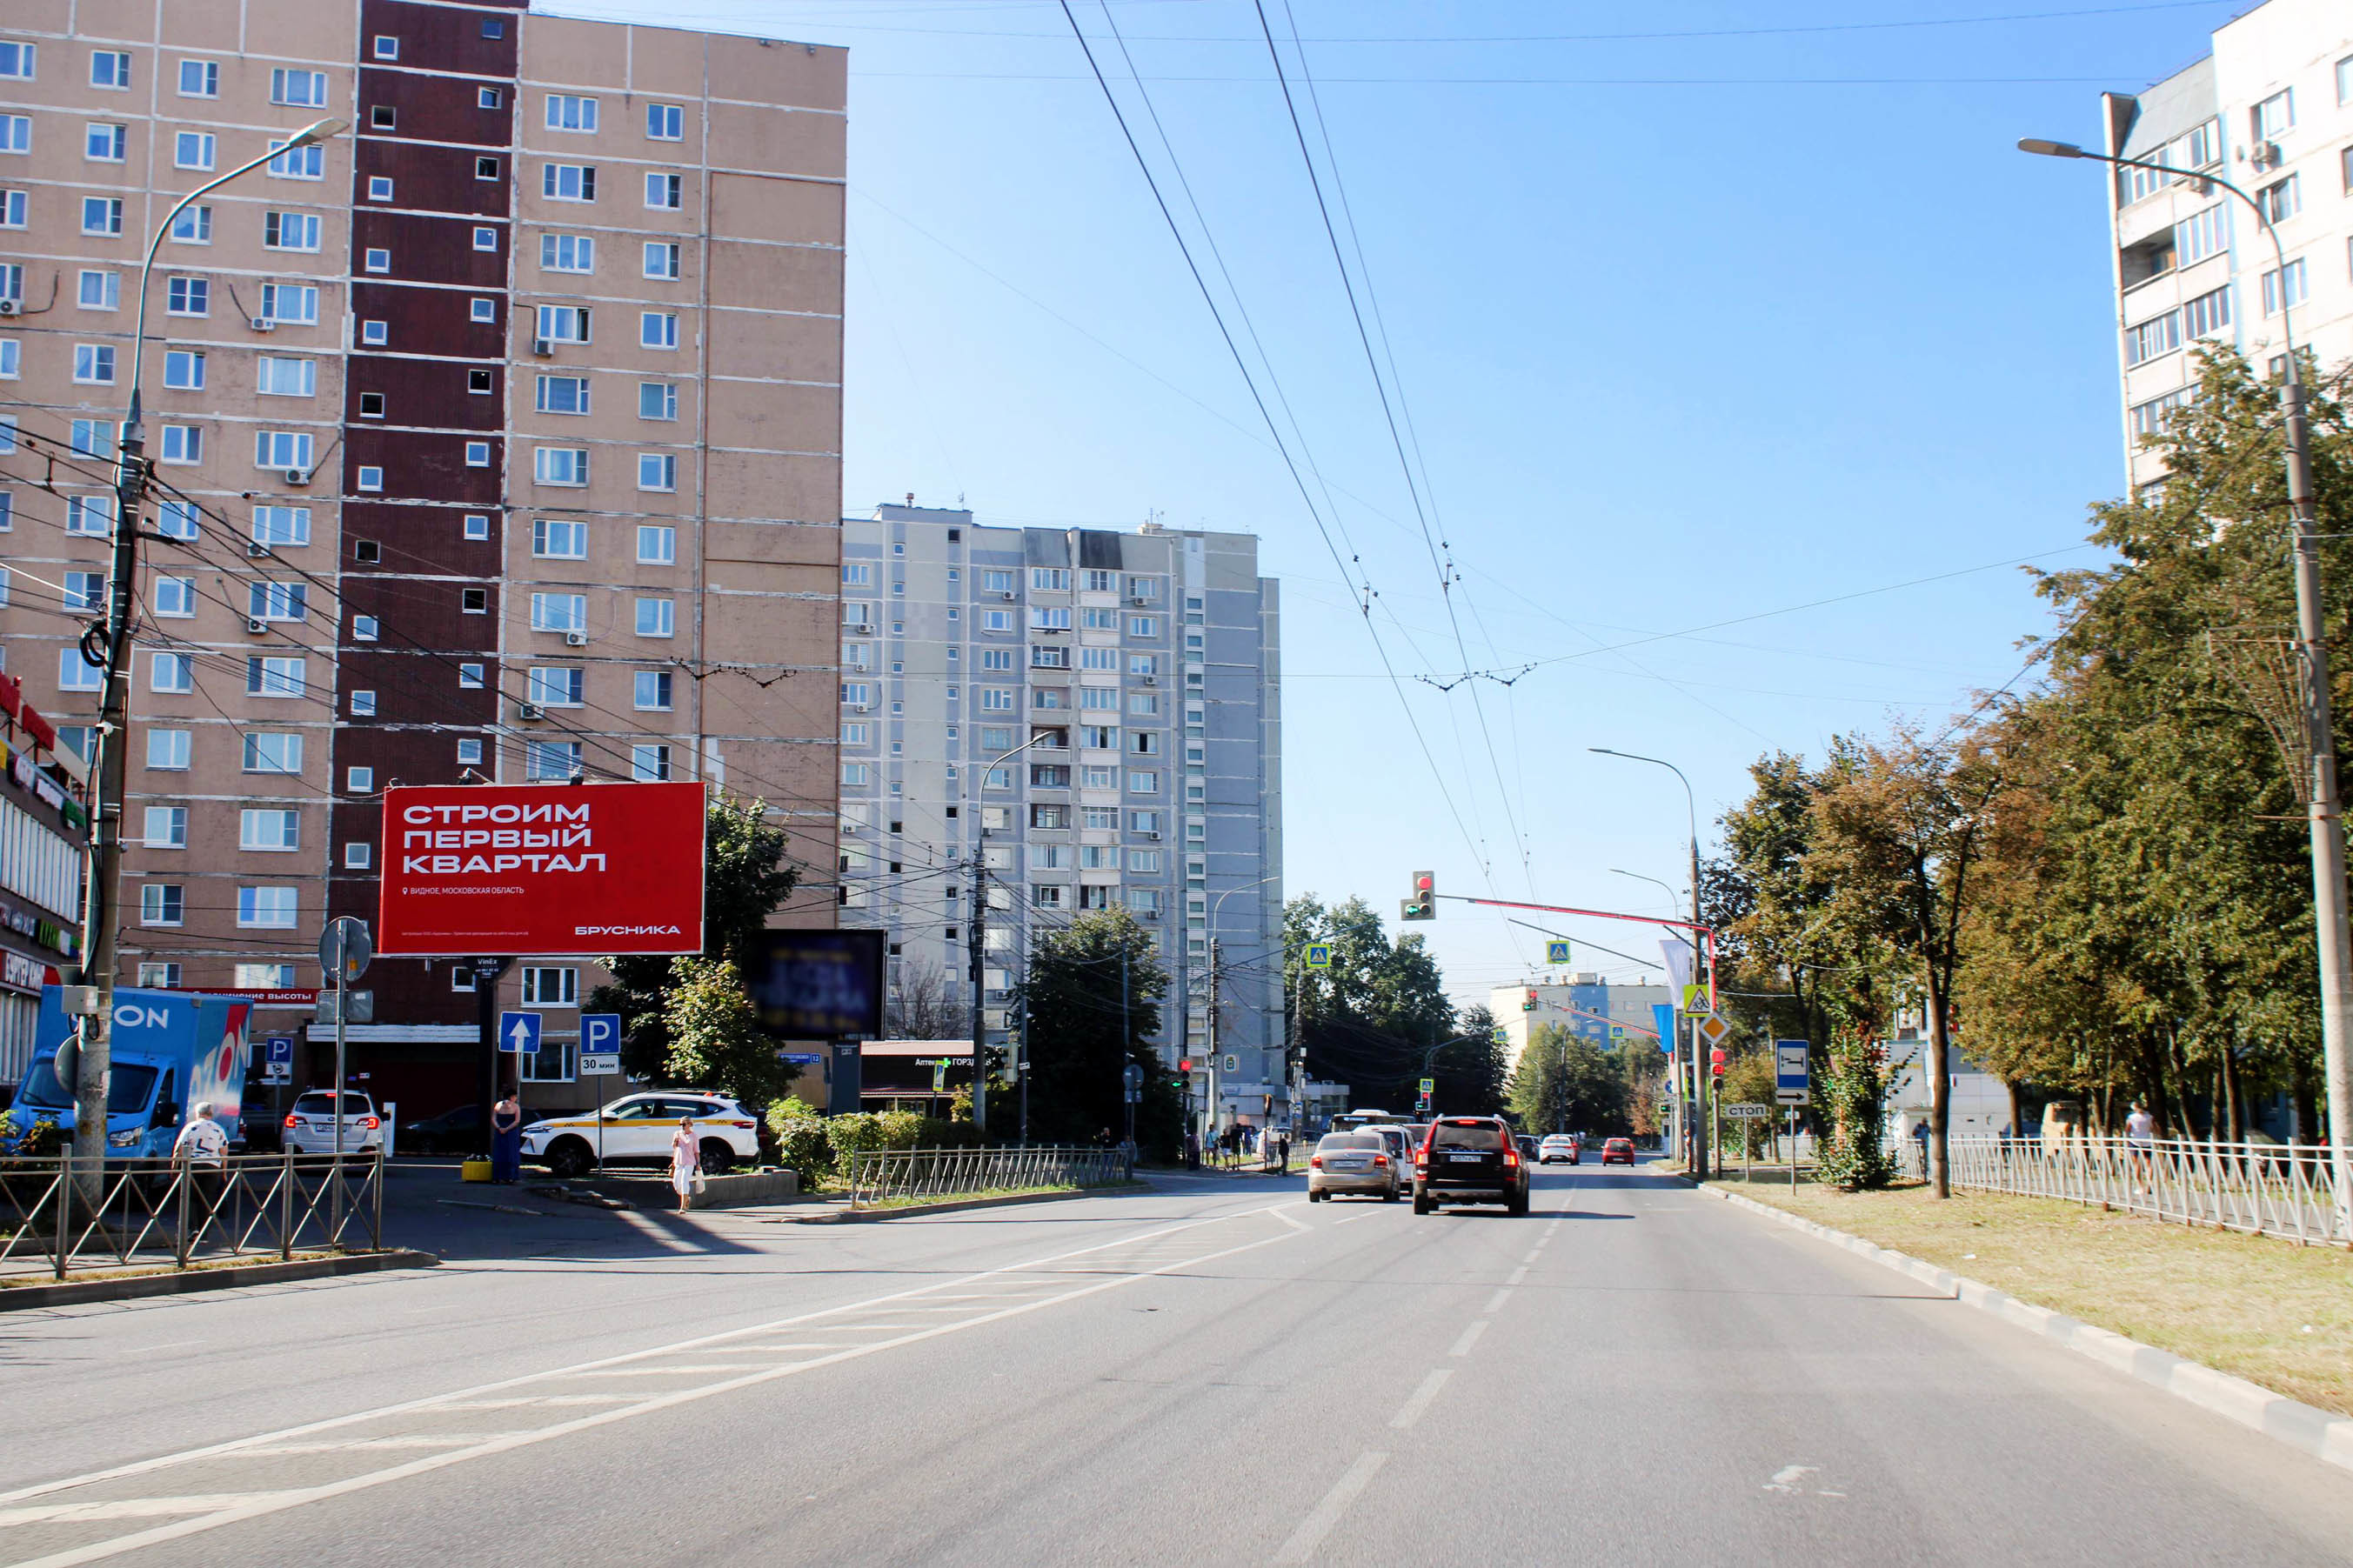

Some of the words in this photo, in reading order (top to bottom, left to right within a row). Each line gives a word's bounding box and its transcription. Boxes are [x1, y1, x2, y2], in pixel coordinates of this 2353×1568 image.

[403, 804, 590, 824] СТРОИМ
[404, 824, 592, 849] ПЕРВЫЙ
[403, 853, 606, 874] КВАРТАЛ
[574, 925, 681, 936] БРУСНИКА
[589, 1020, 611, 1051] P
[583, 1059, 597, 1069] 30
[1729, 1106, 1764, 1116] СТОП
